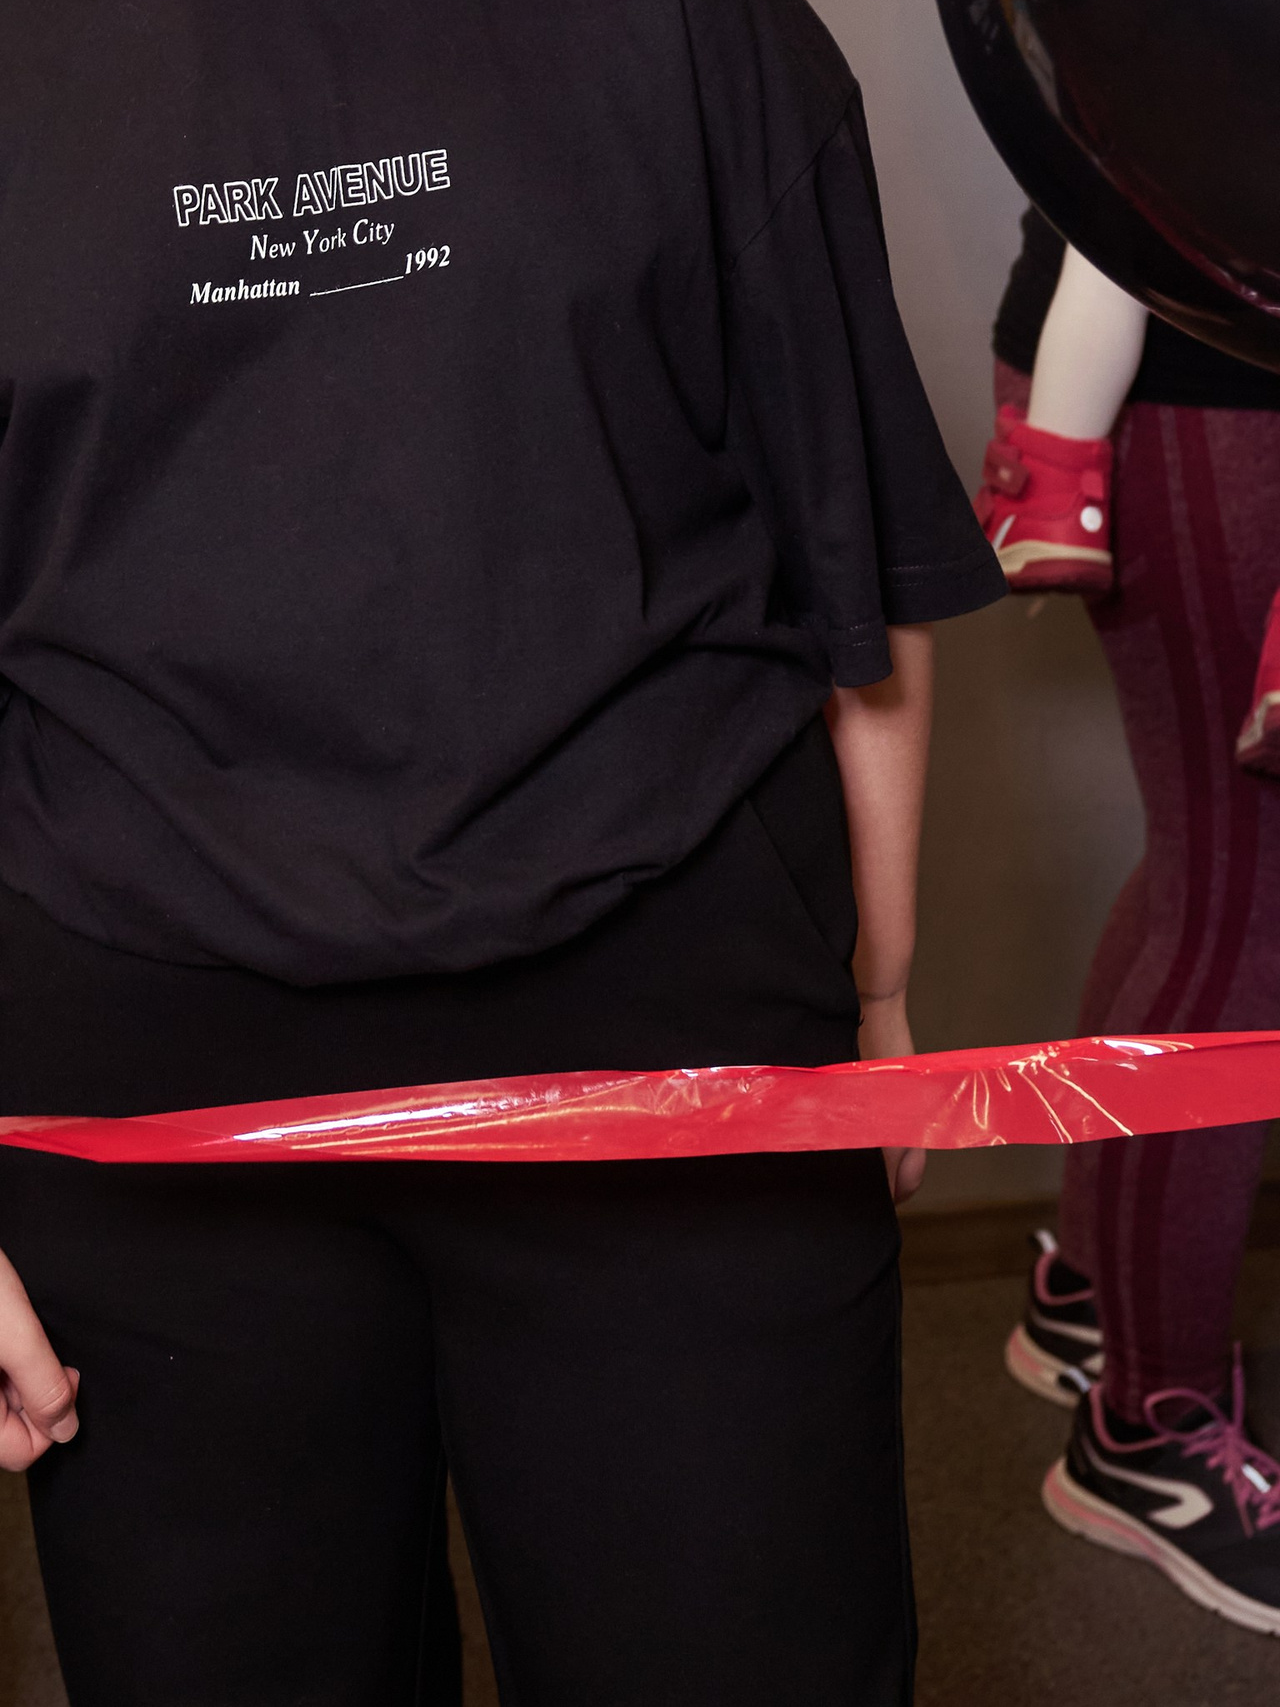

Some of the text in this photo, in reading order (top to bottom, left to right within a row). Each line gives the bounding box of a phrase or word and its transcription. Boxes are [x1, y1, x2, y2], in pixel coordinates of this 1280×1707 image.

[173, 148, 451, 227] PARK AVENUE
[249, 218, 395, 261] New York City
[189, 244, 452, 305] Manhattan 1992
